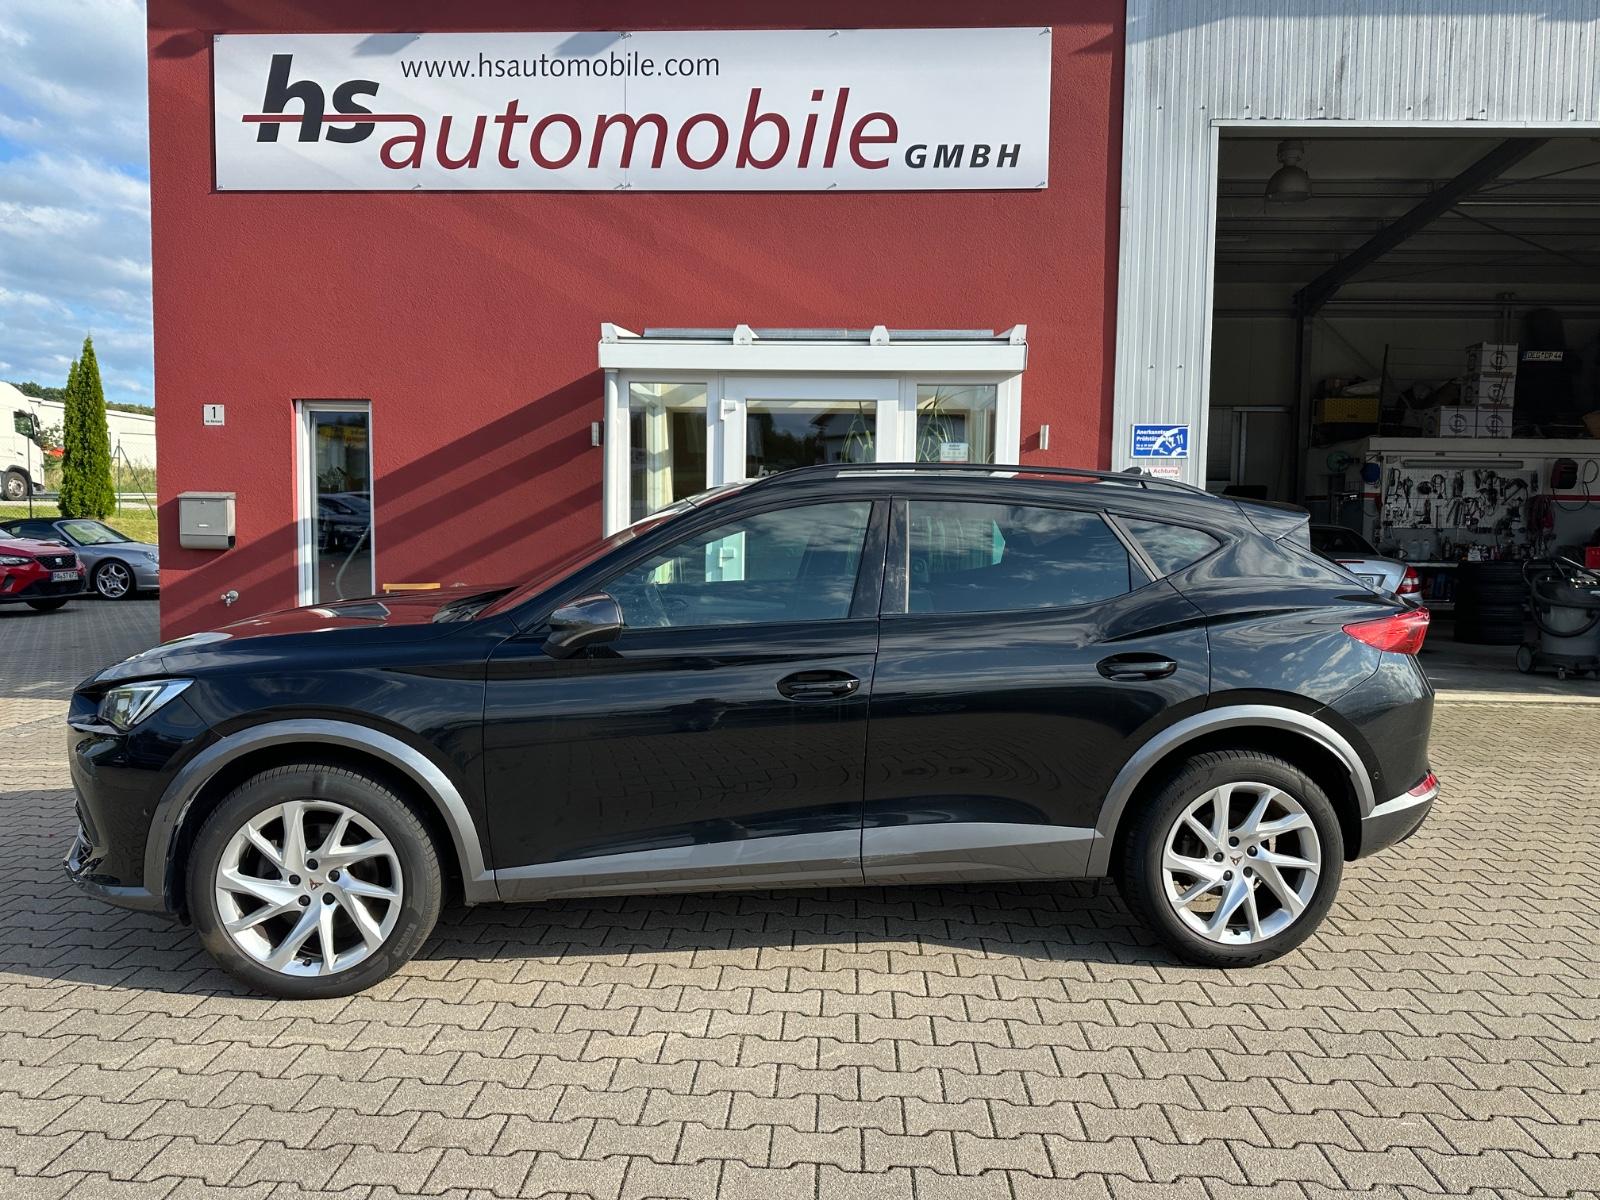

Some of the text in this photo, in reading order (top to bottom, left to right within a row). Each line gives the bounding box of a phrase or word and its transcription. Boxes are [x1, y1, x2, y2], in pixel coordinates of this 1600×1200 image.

[400, 52, 720, 78] www.hsautomobile.com
[256, 54, 1021, 170] hs automobile GMBH
[211, 406, 216, 419] 1
